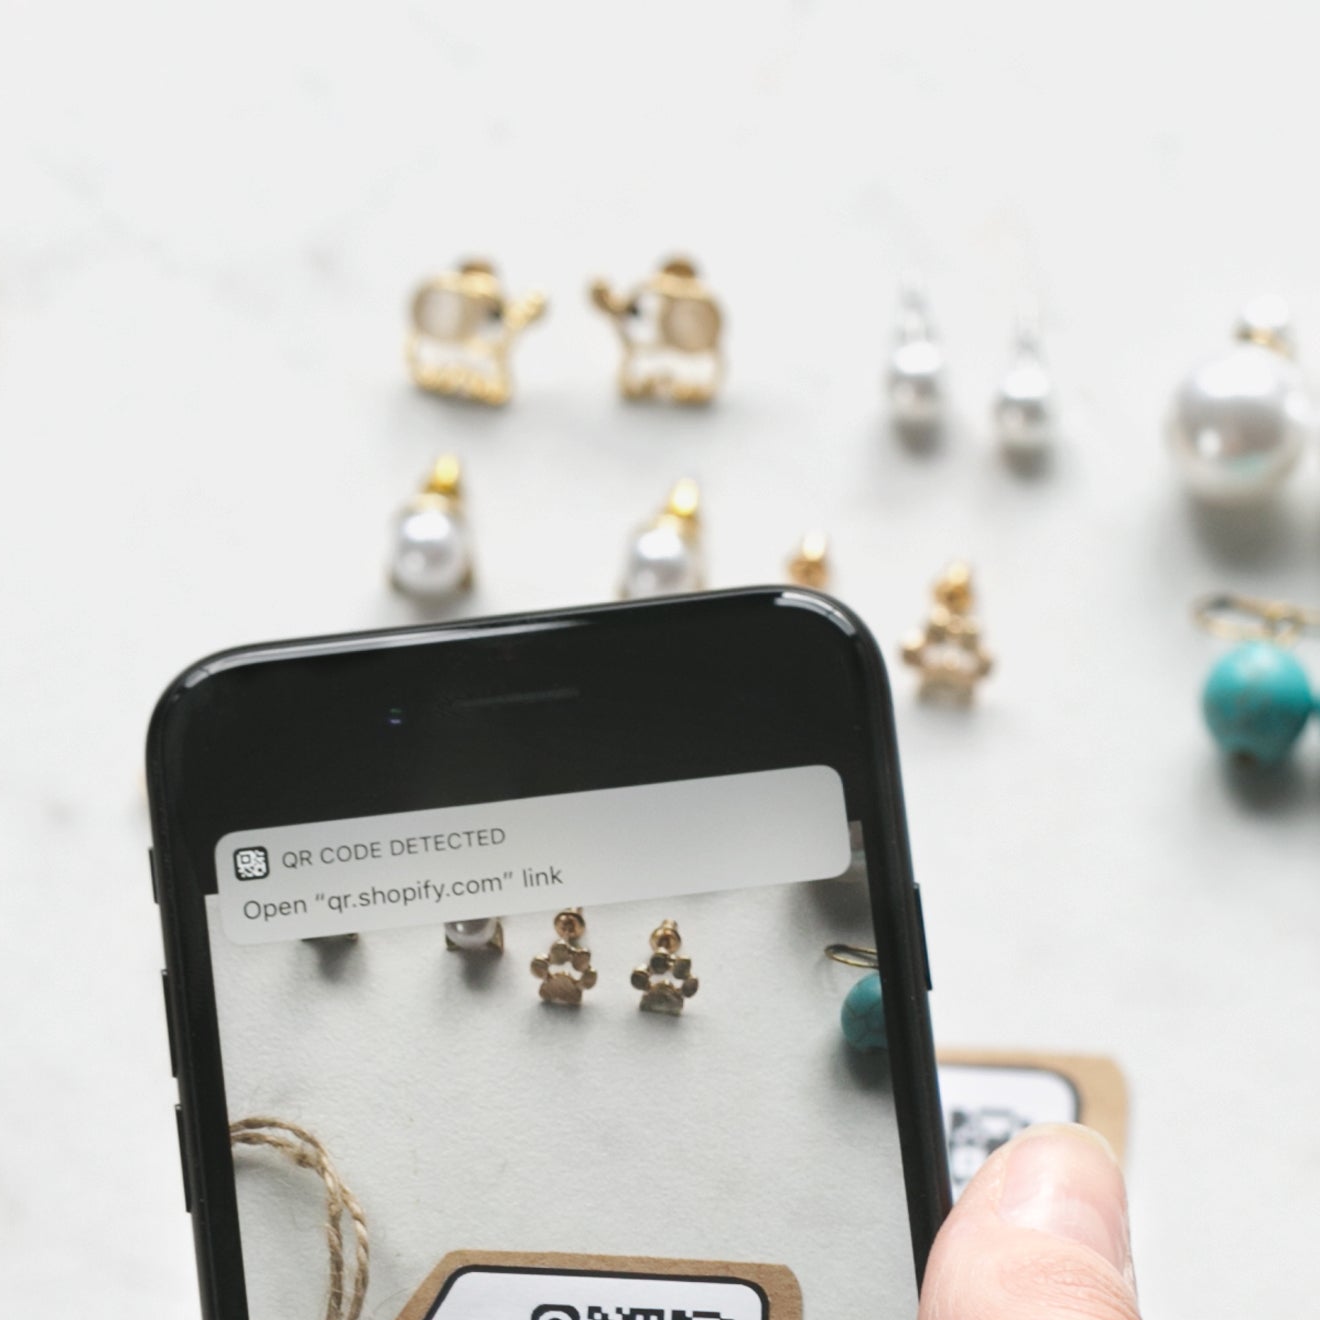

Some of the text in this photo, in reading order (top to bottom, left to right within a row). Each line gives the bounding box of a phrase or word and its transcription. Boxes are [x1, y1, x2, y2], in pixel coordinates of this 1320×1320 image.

[281, 828, 506, 870] QR CODE DETECTED
[243, 894, 308, 922] Open
[523, 865, 563, 890] link
